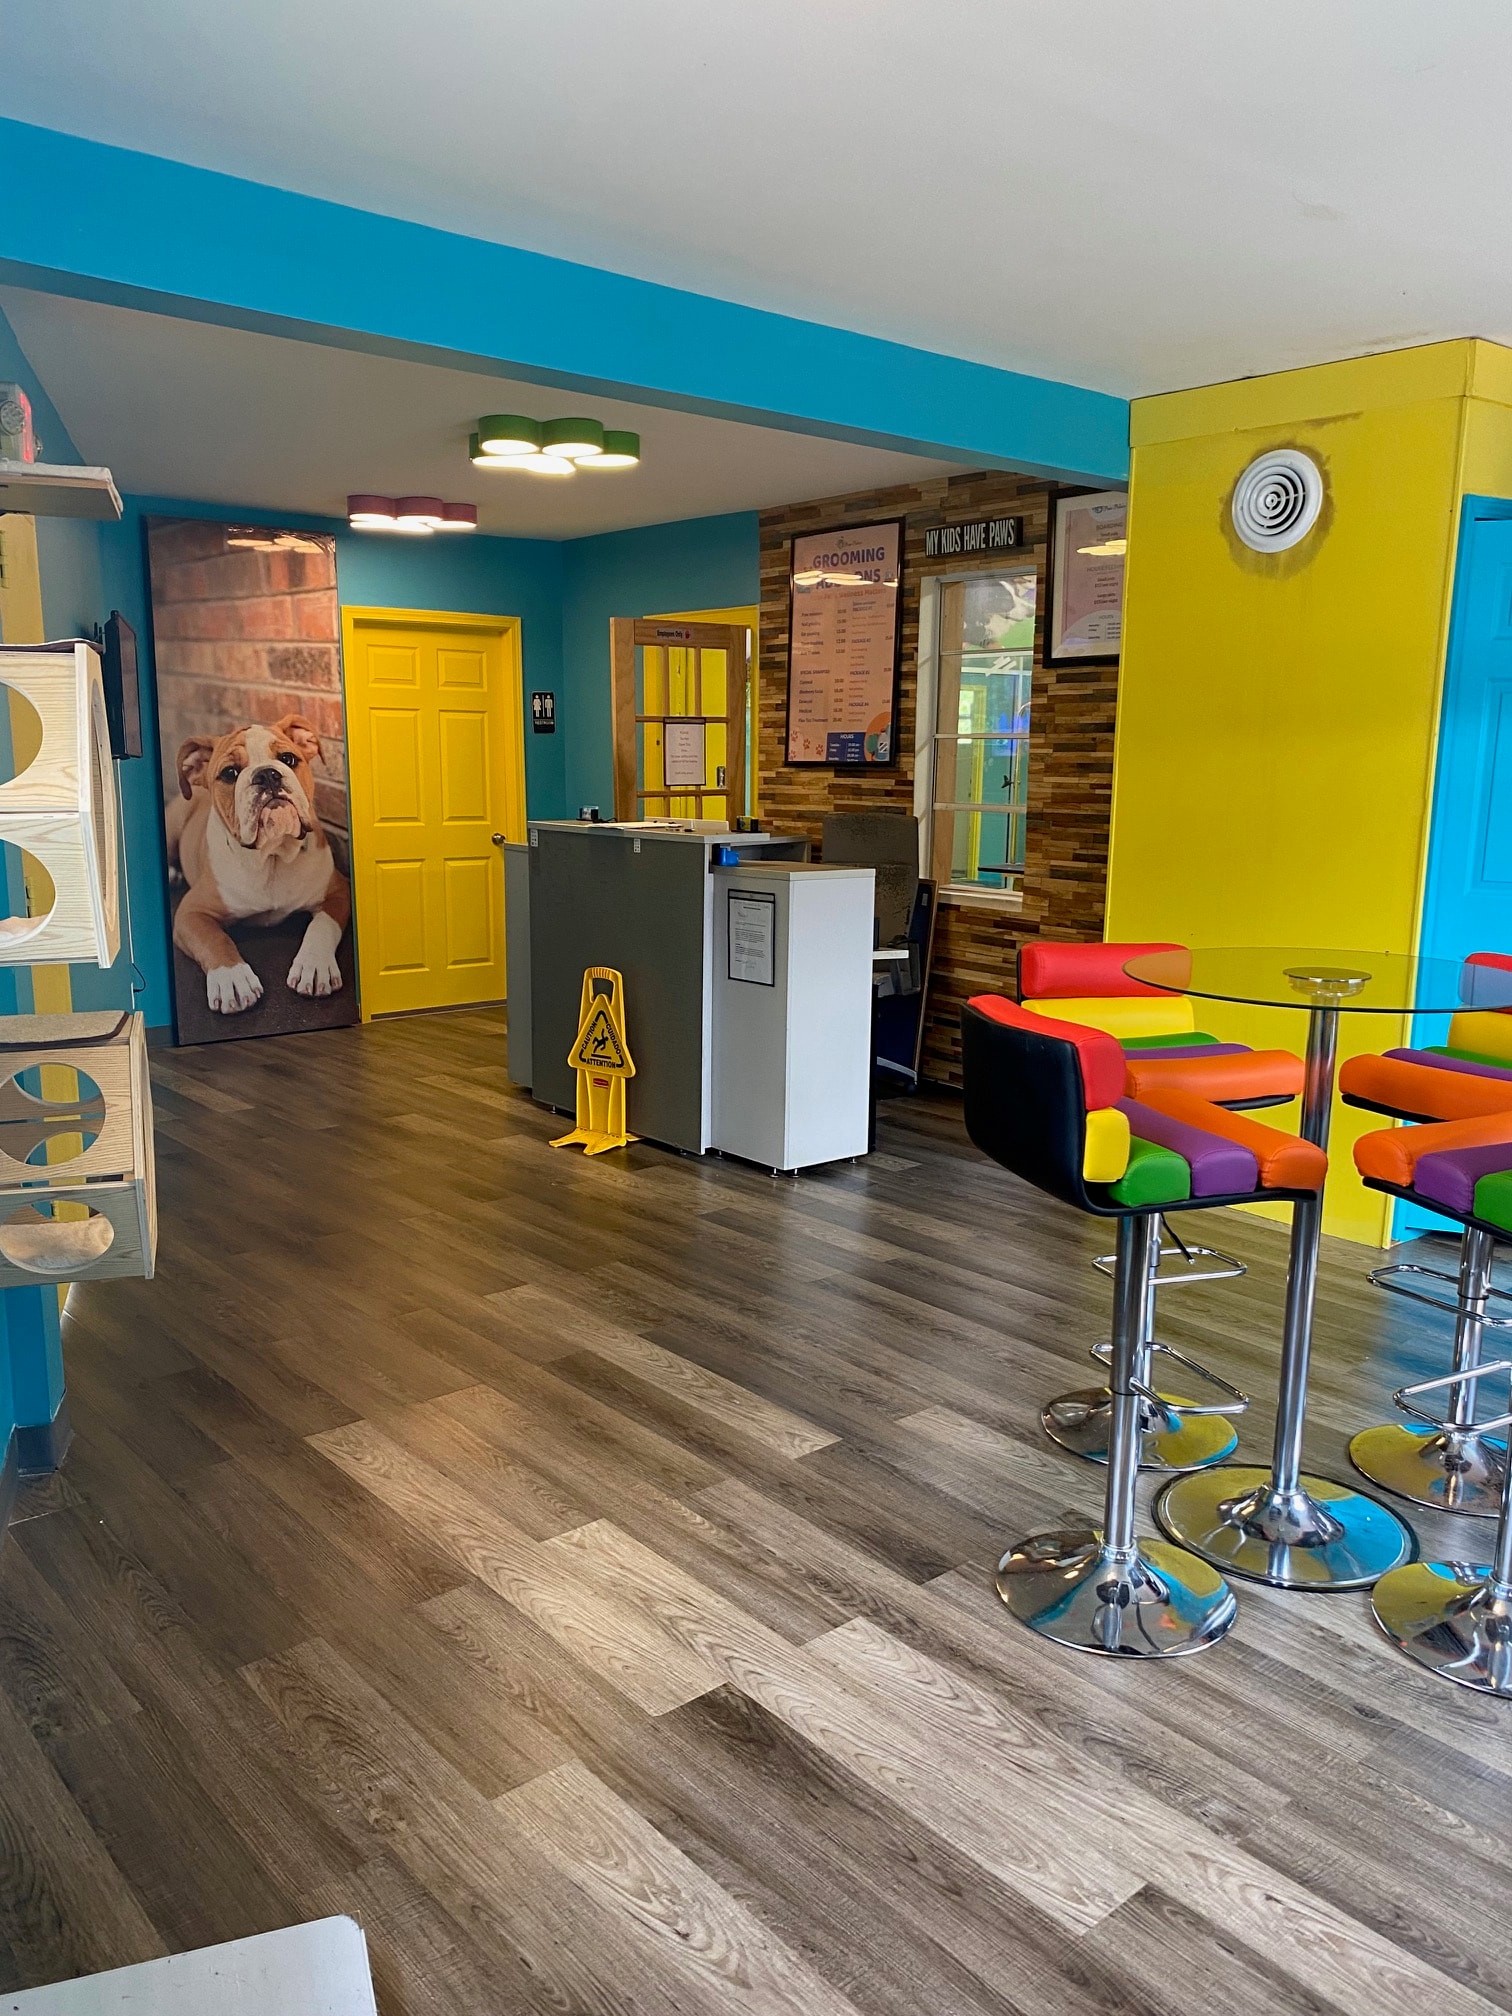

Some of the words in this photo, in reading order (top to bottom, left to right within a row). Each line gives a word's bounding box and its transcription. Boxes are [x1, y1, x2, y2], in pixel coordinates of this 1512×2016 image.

[925, 529, 939, 556] MY
[941, 526, 961, 554] KIDS
[963, 522, 986, 551] HAVE
[989, 518, 1015, 547] PAWS
[812, 546, 884, 569] GROOMING
[581, 1020, 598, 1051] CAUTION
[605, 1023, 622, 1055] CUIDADO
[586, 1058, 617, 1069] ATTENTION
